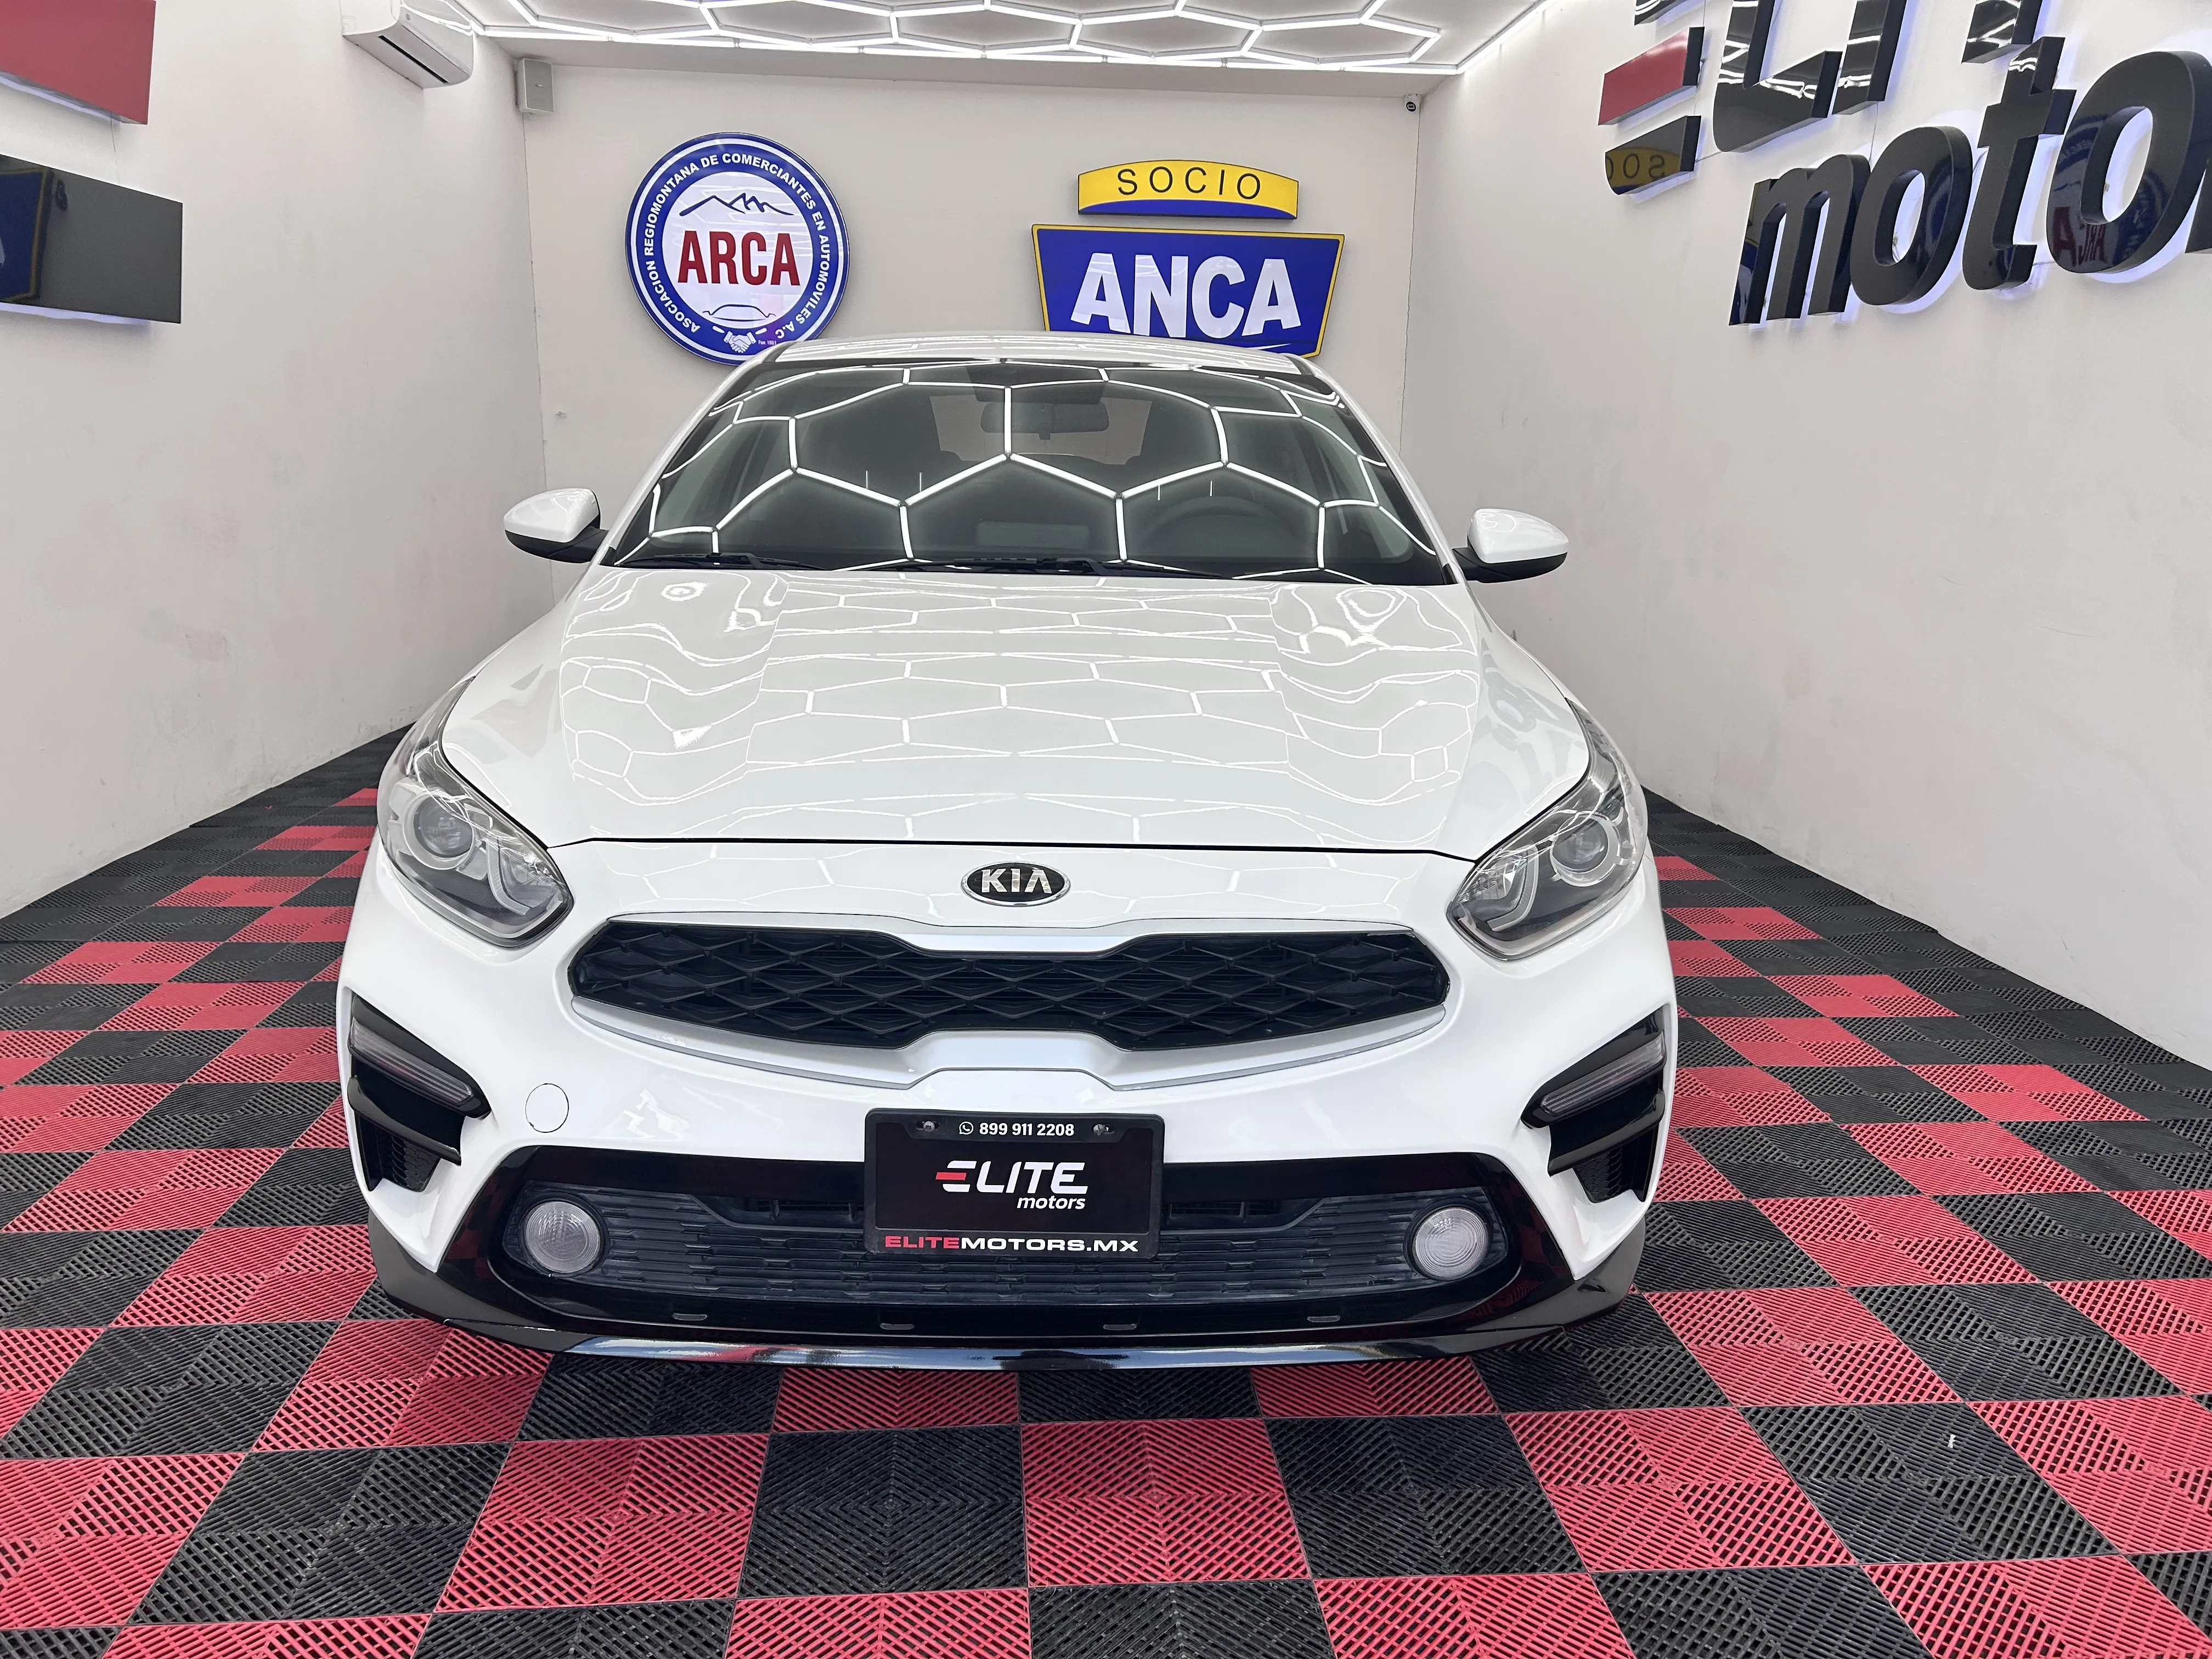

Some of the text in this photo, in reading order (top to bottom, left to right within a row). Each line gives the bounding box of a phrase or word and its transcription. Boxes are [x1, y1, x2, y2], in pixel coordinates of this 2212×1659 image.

[700, 154, 719, 169] DE
[722, 153, 816, 211] COMERCIANTES
[1117, 166, 1261, 200] SOCIO
[645, 163, 699, 256] REGIOMONTANA
[811, 211, 826, 231] EN
[678, 230, 801, 286] ARCA
[645, 258, 701, 334] ASOCIACION
[795, 234, 831, 325] AUTOMOVILES
[1070, 252, 1301, 338] ANCA
[981, 868, 1052, 894] KIA
[979, 1122, 1074, 1136] 899 911 2208
[935, 1160, 1088, 1194] ELITE
[1017, 1195, 1086, 1209] motors
[885, 1235, 1138, 1252] ELITEMOTORS.MX
